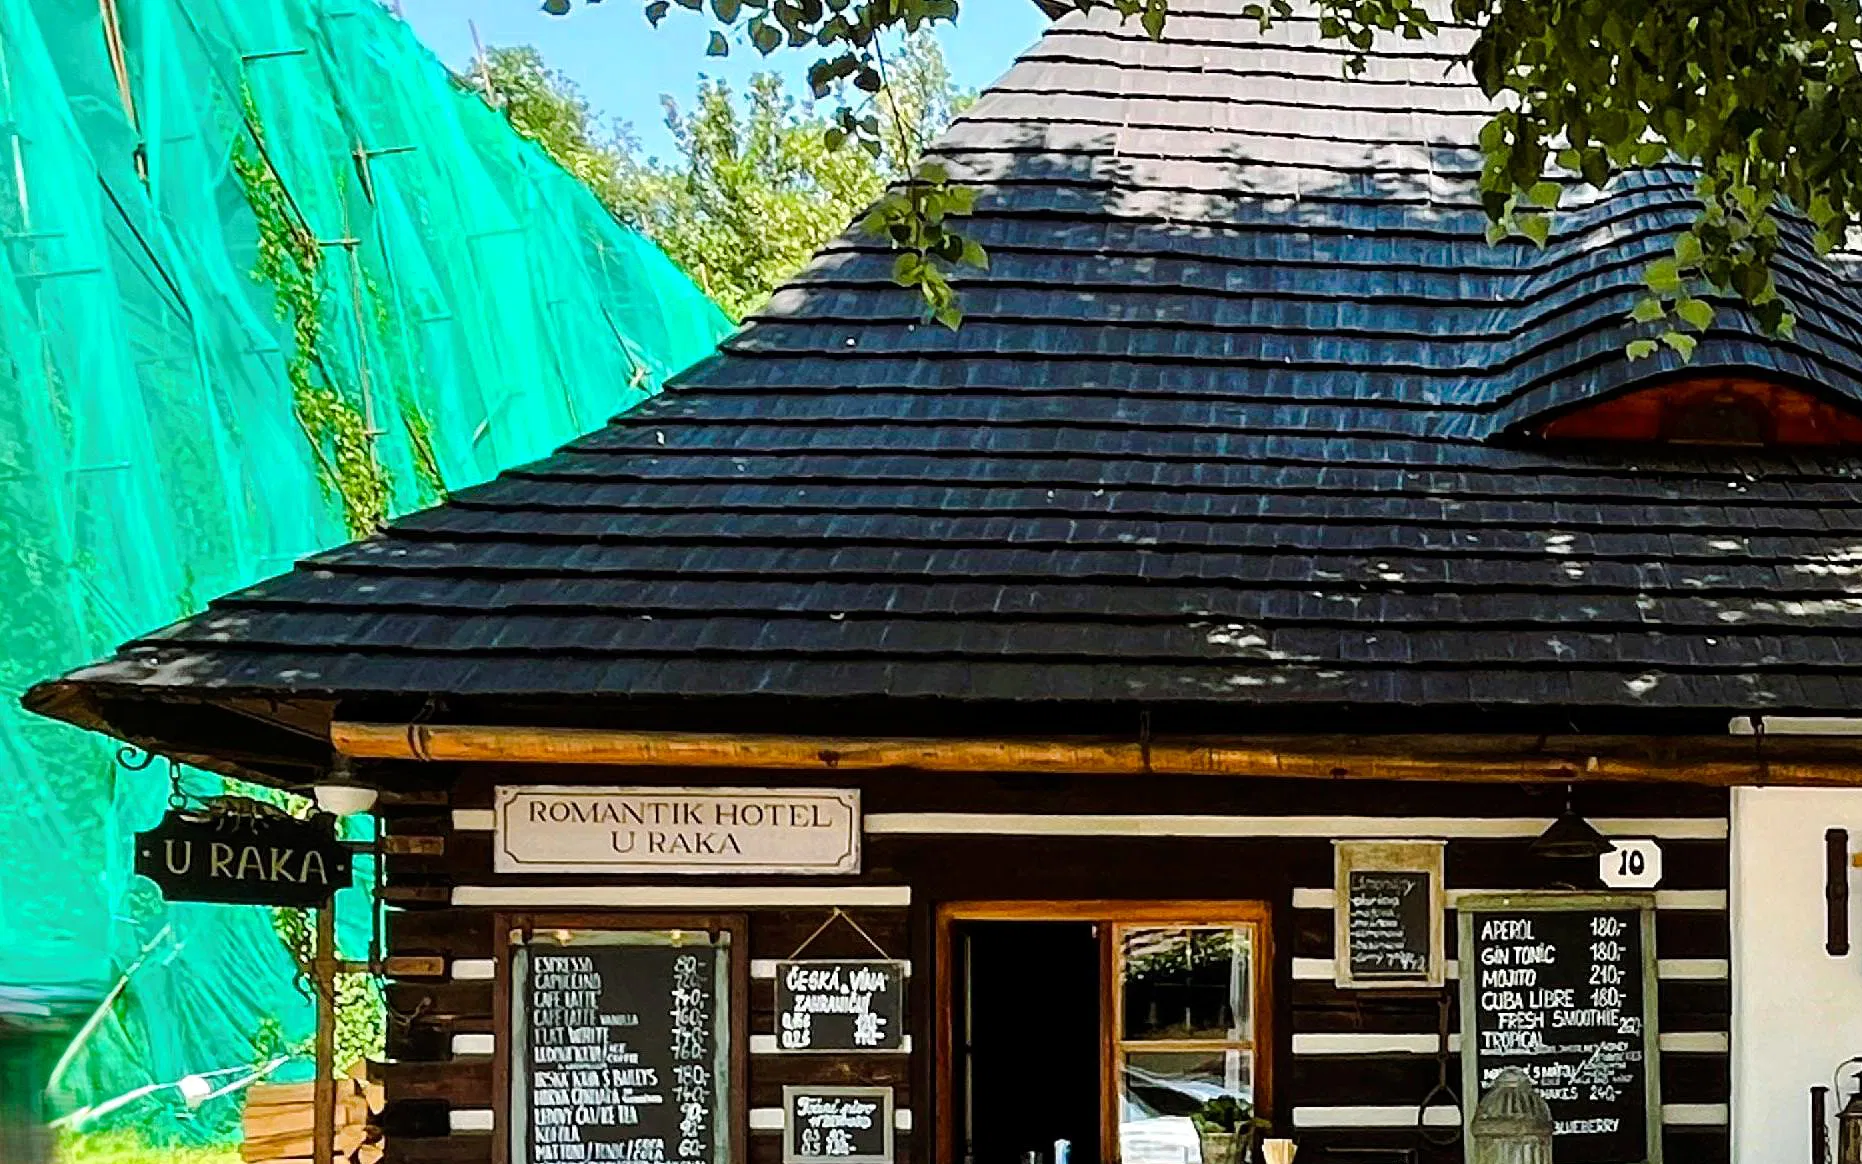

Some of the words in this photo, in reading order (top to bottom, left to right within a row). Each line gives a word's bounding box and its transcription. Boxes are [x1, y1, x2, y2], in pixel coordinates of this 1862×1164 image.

[528, 801, 703, 826] ROMANTIK
[714, 803, 834, 829] HOTEL
[611, 831, 635, 854] U
[648, 831, 742, 855] RAKA
[164, 838, 192, 875] U
[209, 842, 329, 885] RAKA
[1618, 849, 1645, 876] 10
[1481, 919, 1535, 941] APEROL
[1481, 945, 1509, 965] GIN
[1513, 942, 1556, 965] TONIC
[1482, 968, 1537, 988] MOJITO
[1481, 990, 1524, 1011] CUBA
[1529, 987, 1575, 1009] LIBRE
[1498, 1010, 1544, 1029] FRESH
[1552, 1007, 1620, 1027] SMOOTHIE
[1481, 1030, 1543, 1049] TROPICAL
